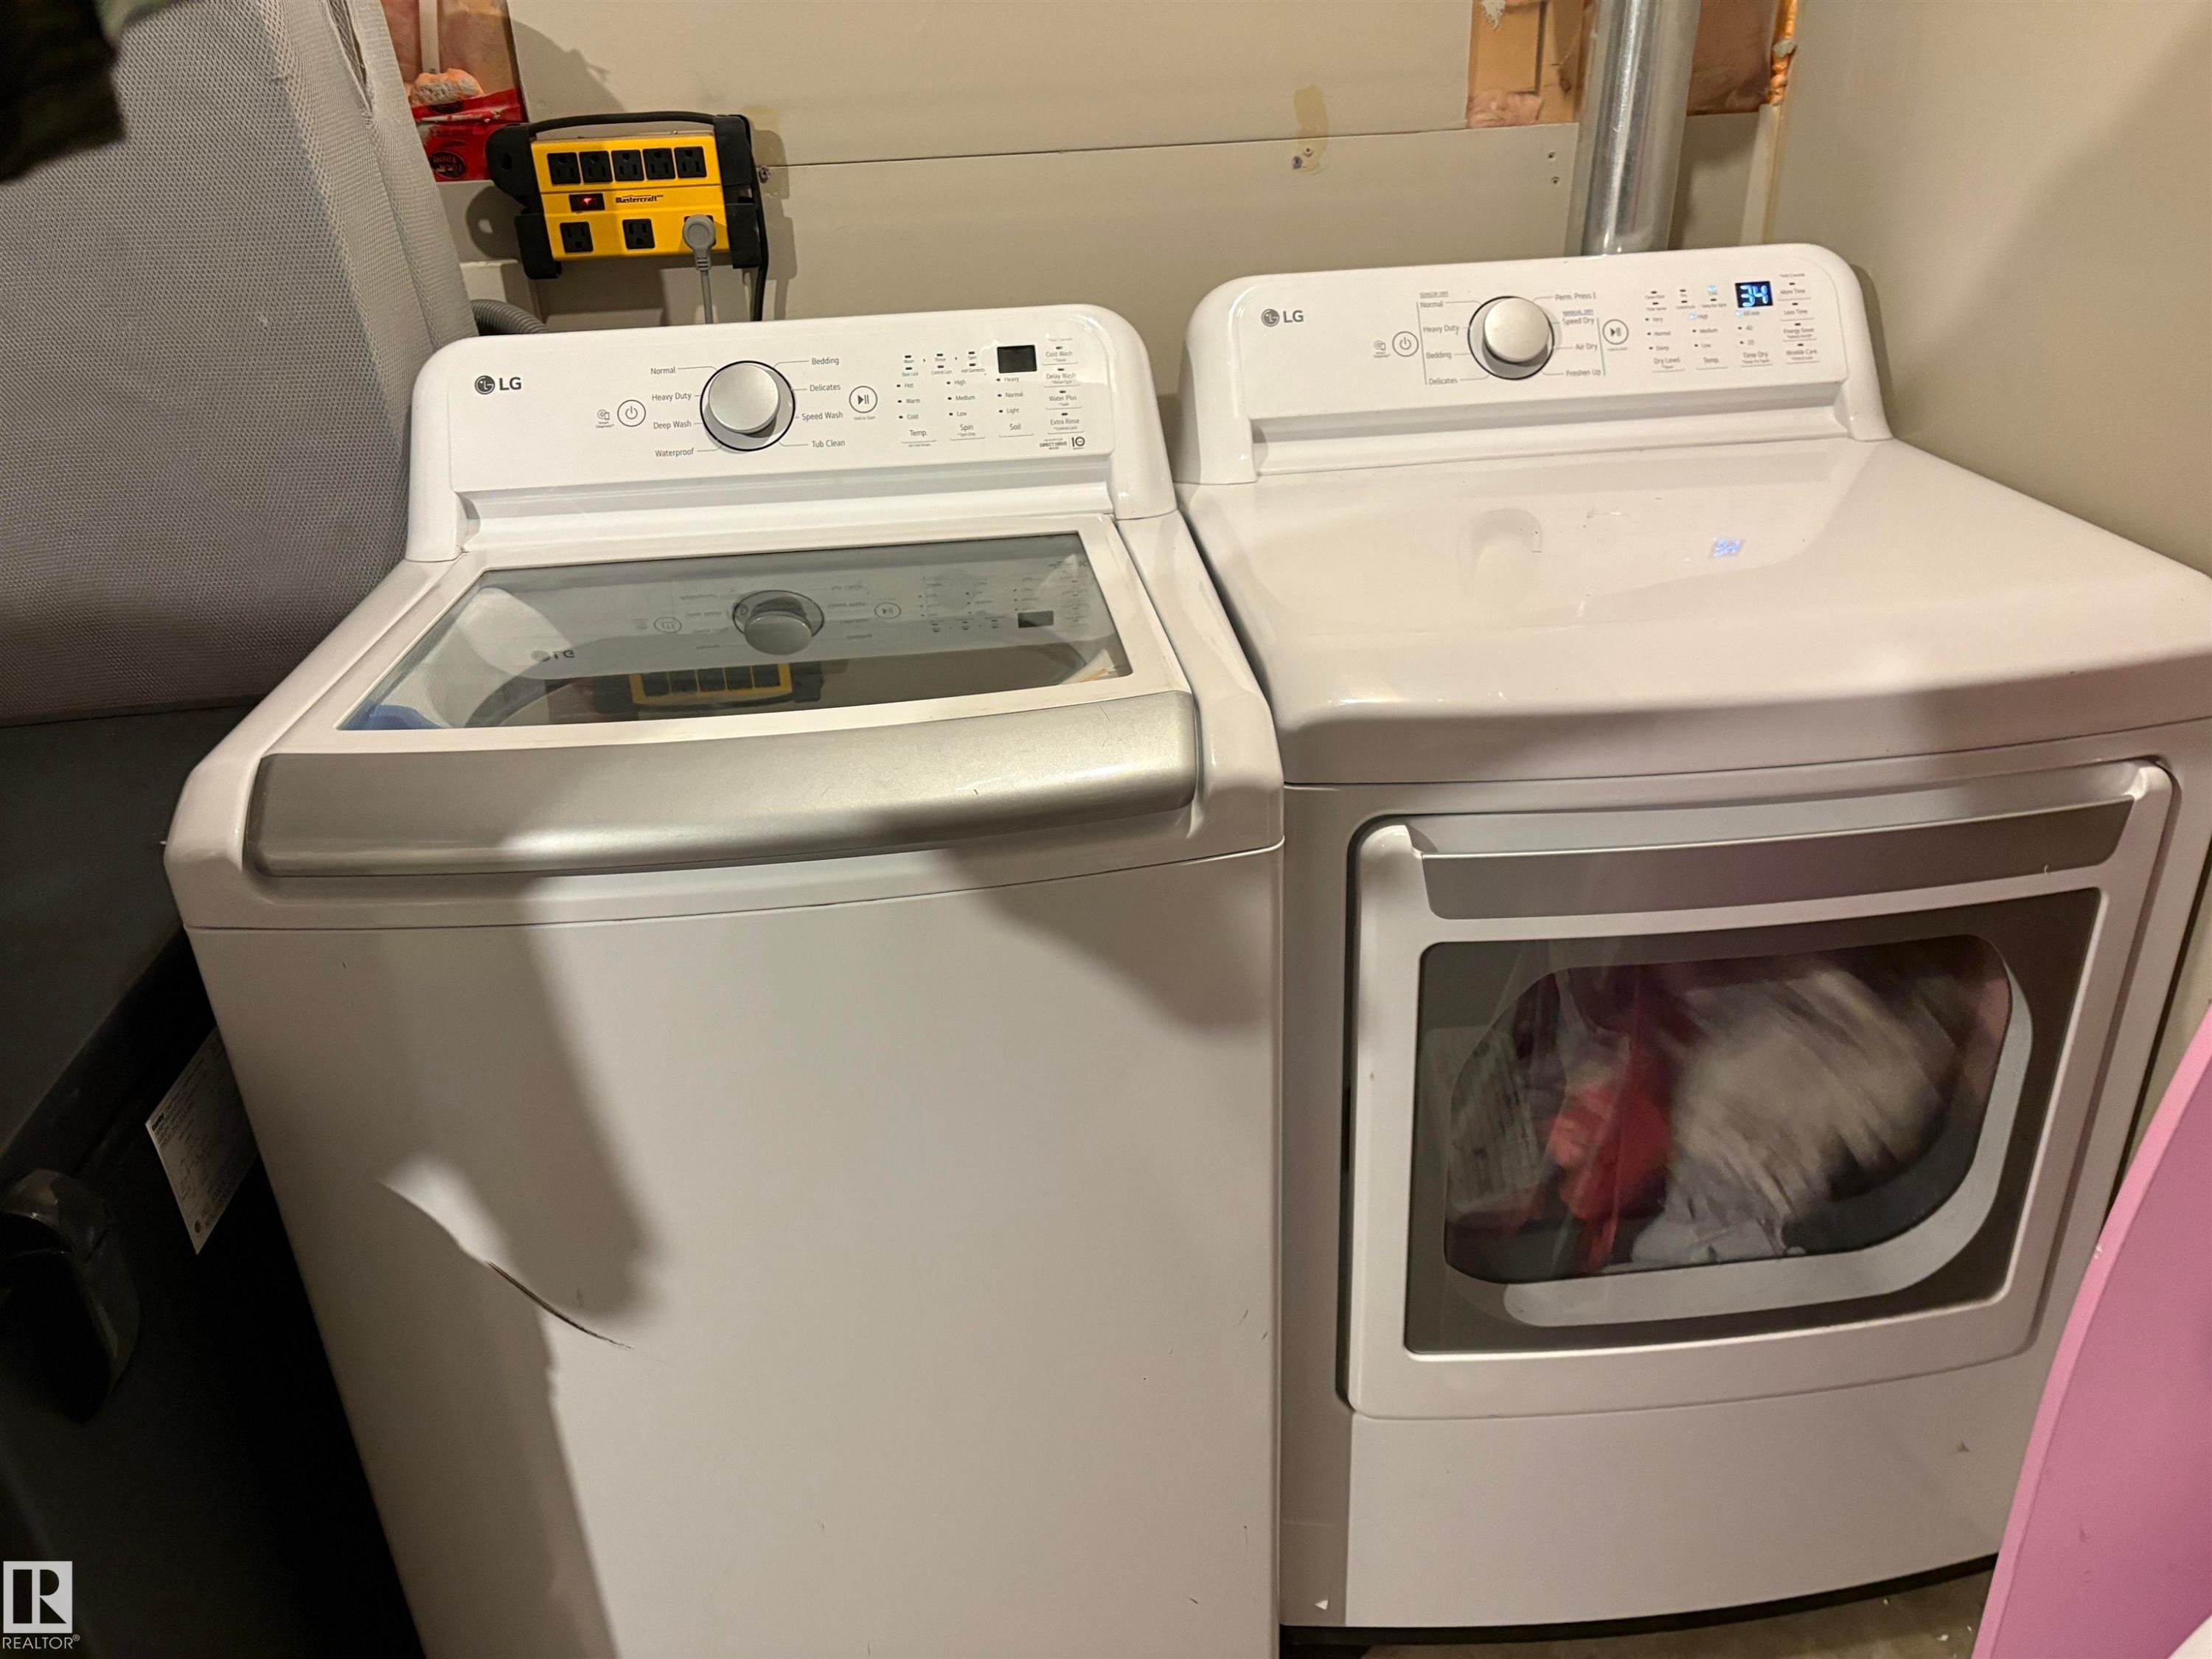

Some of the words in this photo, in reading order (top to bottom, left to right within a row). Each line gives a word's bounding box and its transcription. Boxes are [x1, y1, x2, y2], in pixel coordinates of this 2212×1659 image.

[1739, 284, 1769, 307] 34
[1283, 310, 1304, 323] LG
[1562, 317, 1582, 325] Speed
[1583, 316, 1595, 325] Dry
[1423, 326, 1443, 334] Heavy
[1444, 324, 1460, 333] Duty
[1586, 343, 1598, 351] Dry
[1425, 352, 1452, 360] Bedding
[811, 357, 840, 366] Bedding
[650, 366, 676, 375] Normal
[1592, 369, 1601, 377] Up
[499, 377, 522, 391] LG
[1428, 377, 1458, 385] Delicates
[810, 383, 841, 392] Delicates
[652, 394, 673, 403] Heavy
[675, 392, 692, 400] Duty
[801, 412, 823, 422] Speed
[824, 411, 844, 420] Wash
[653, 421, 672, 431] Deep
[672, 420, 692, 428] Wash
[959, 424, 974, 432] Spin
[1009, 422, 1022, 431] Soil
[812, 440, 824, 448] Tub
[826, 439, 846, 448] Clean
[655, 447, 695, 458] Waterproof
